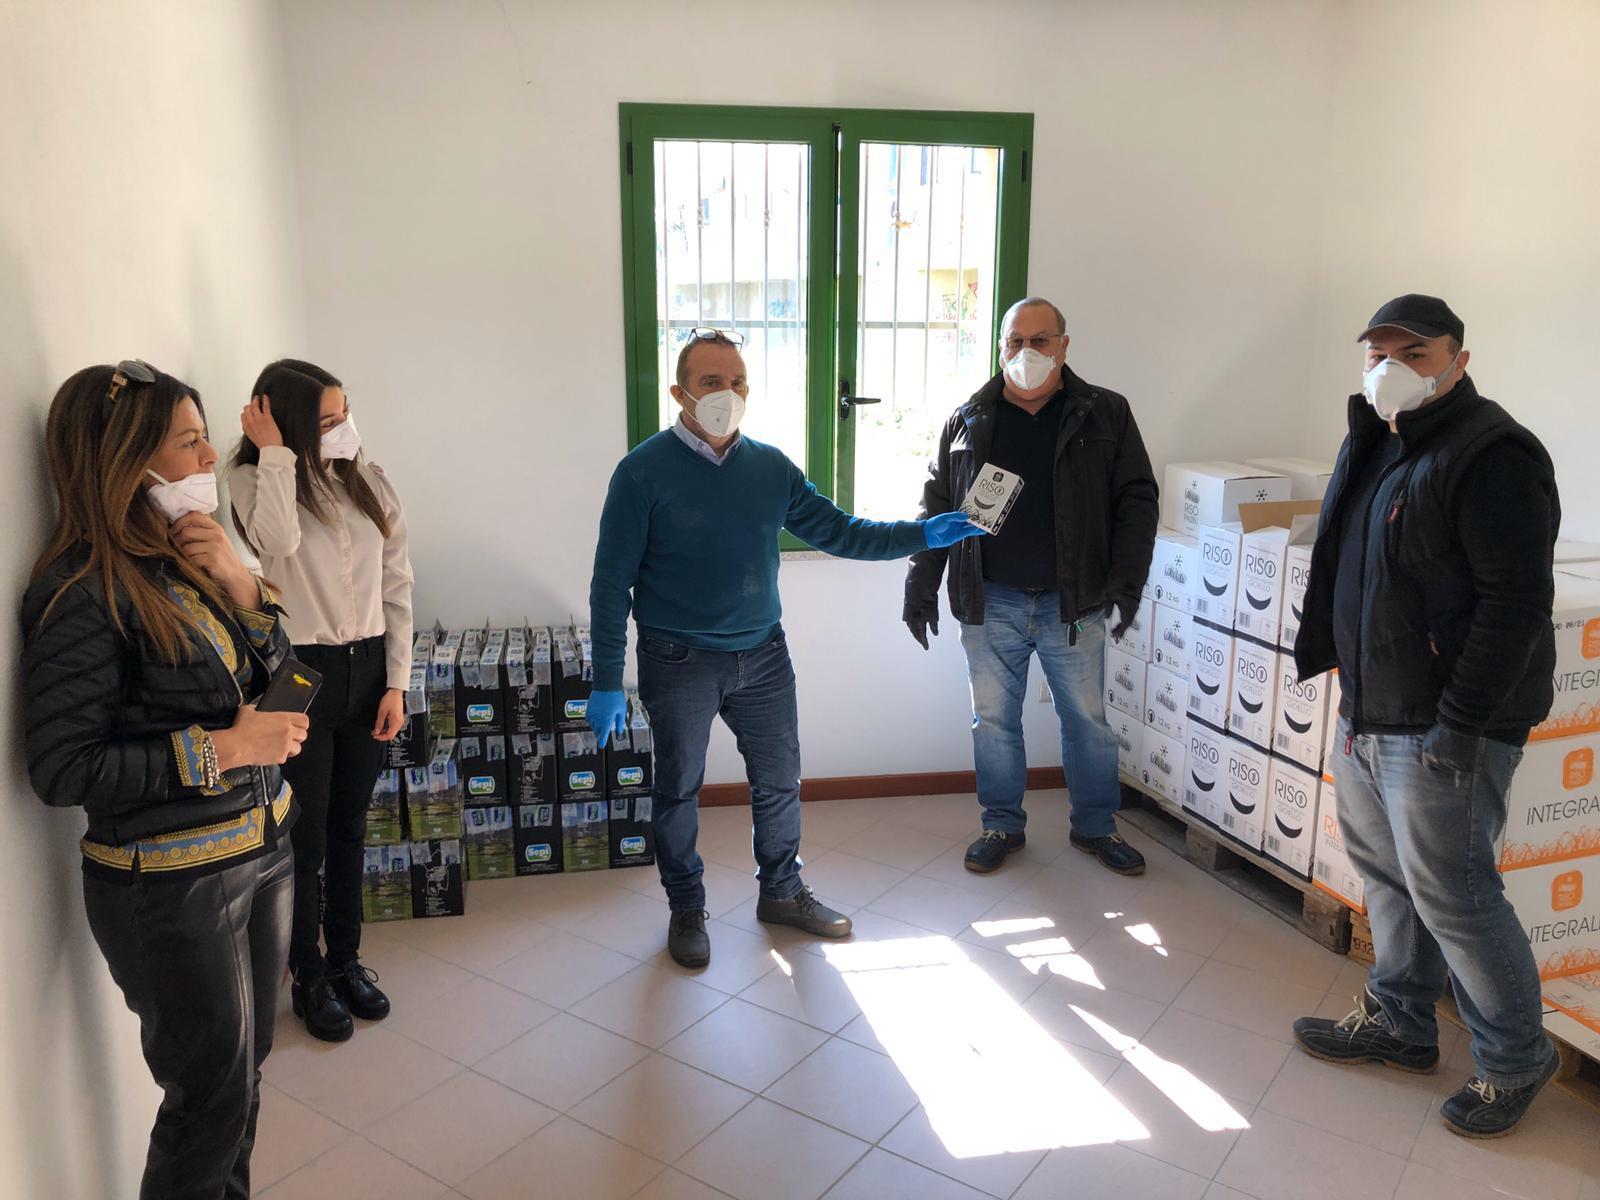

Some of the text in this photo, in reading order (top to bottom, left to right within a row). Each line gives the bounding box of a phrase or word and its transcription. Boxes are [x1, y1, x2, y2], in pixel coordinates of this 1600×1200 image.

[978, 478, 1005, 496] RISO
[1203, 542, 1232, 566] RISO
[1245, 554, 1276, 578] RISO
[1291, 566, 1310, 587] RIS
[1195, 641, 1224, 666] RISO
[1238, 657, 1267, 683] RISO
[1552, 669, 1600, 692] NTEG
[1284, 674, 1317, 701] RISO
[1191, 737, 1219, 764] RISO
[571, 773, 593, 786] Sepi
[620, 769, 641, 782] Sepi
[1229, 758, 1260, 786] RISO
[471, 779, 493, 791] Sepi
[1275, 779, 1308, 808] RISO
[527, 846, 550, 858] Sepi
[622, 839, 644, 851] Sepi
